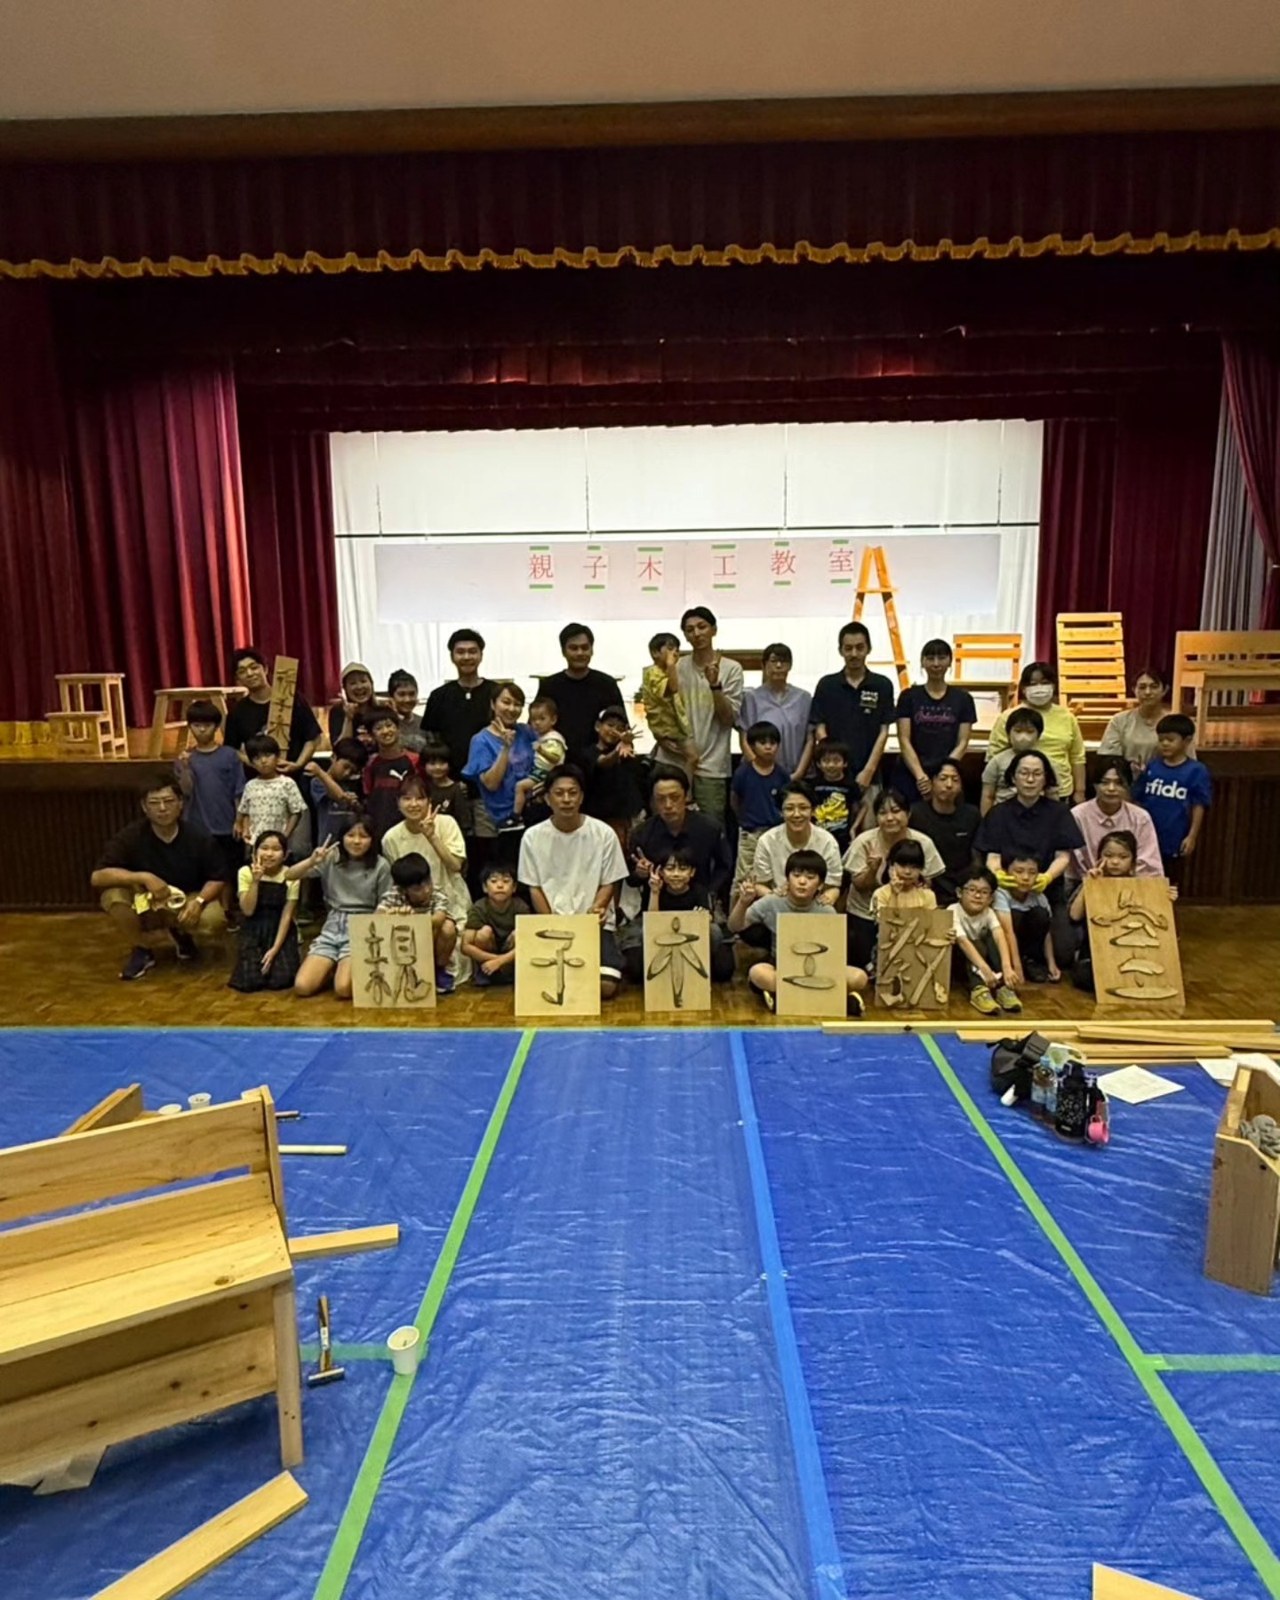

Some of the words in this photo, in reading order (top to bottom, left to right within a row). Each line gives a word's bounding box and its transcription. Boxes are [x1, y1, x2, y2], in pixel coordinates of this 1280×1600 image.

[529, 548, 854, 580] 親子木工教室
[363, 920, 432, 1006] 親
[530, 929, 586, 1006] 子
[646, 916, 709, 1008] 木
[782, 941, 837, 990] 工
